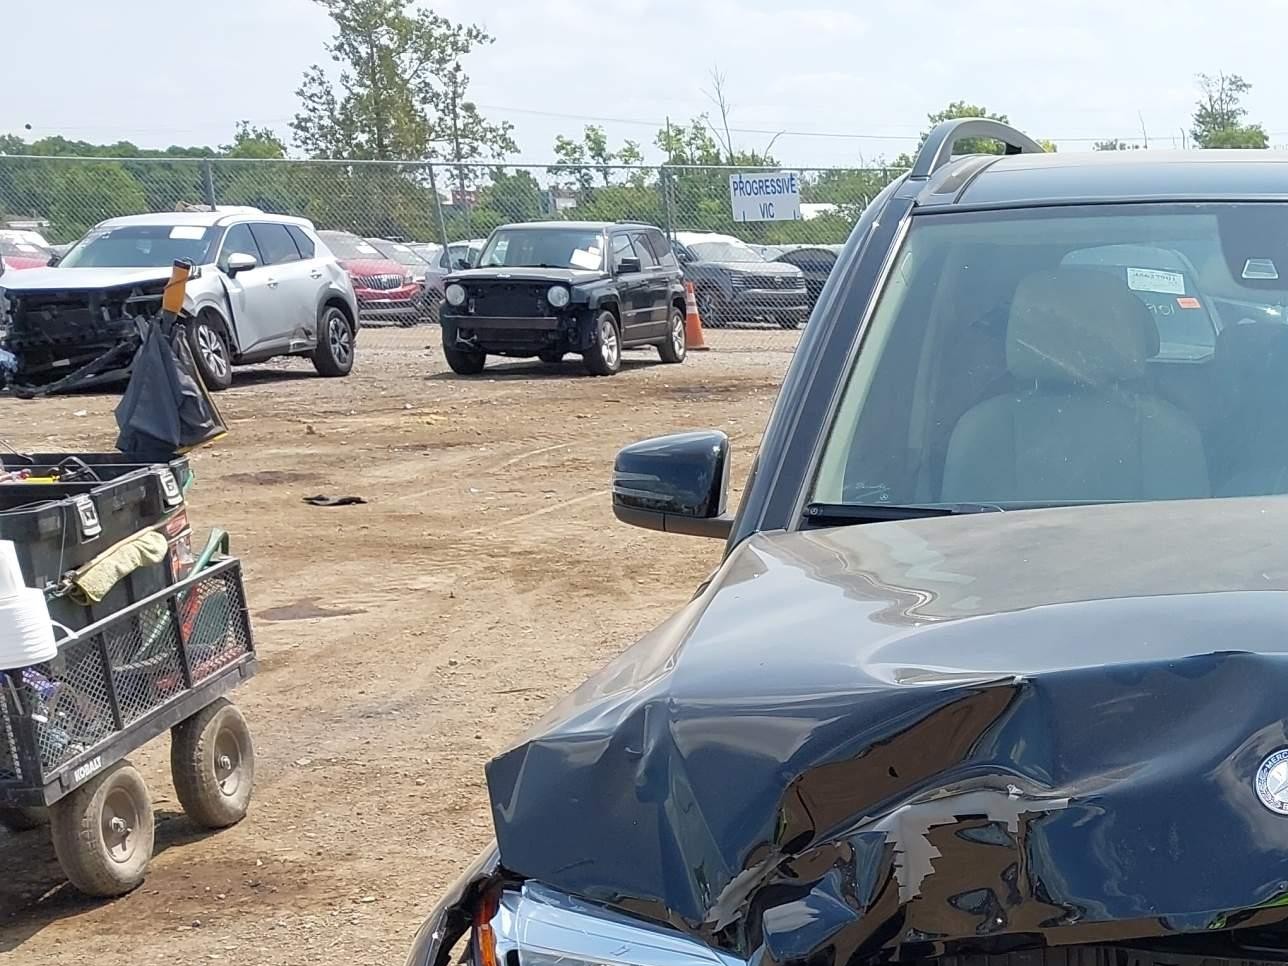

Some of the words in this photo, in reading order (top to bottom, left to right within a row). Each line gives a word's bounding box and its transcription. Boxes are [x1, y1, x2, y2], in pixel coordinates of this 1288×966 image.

[732, 177, 797, 197] PROGRESSIVE
[759, 202, 775, 219] VIC
[73, 755, 102, 783] KOBALT
